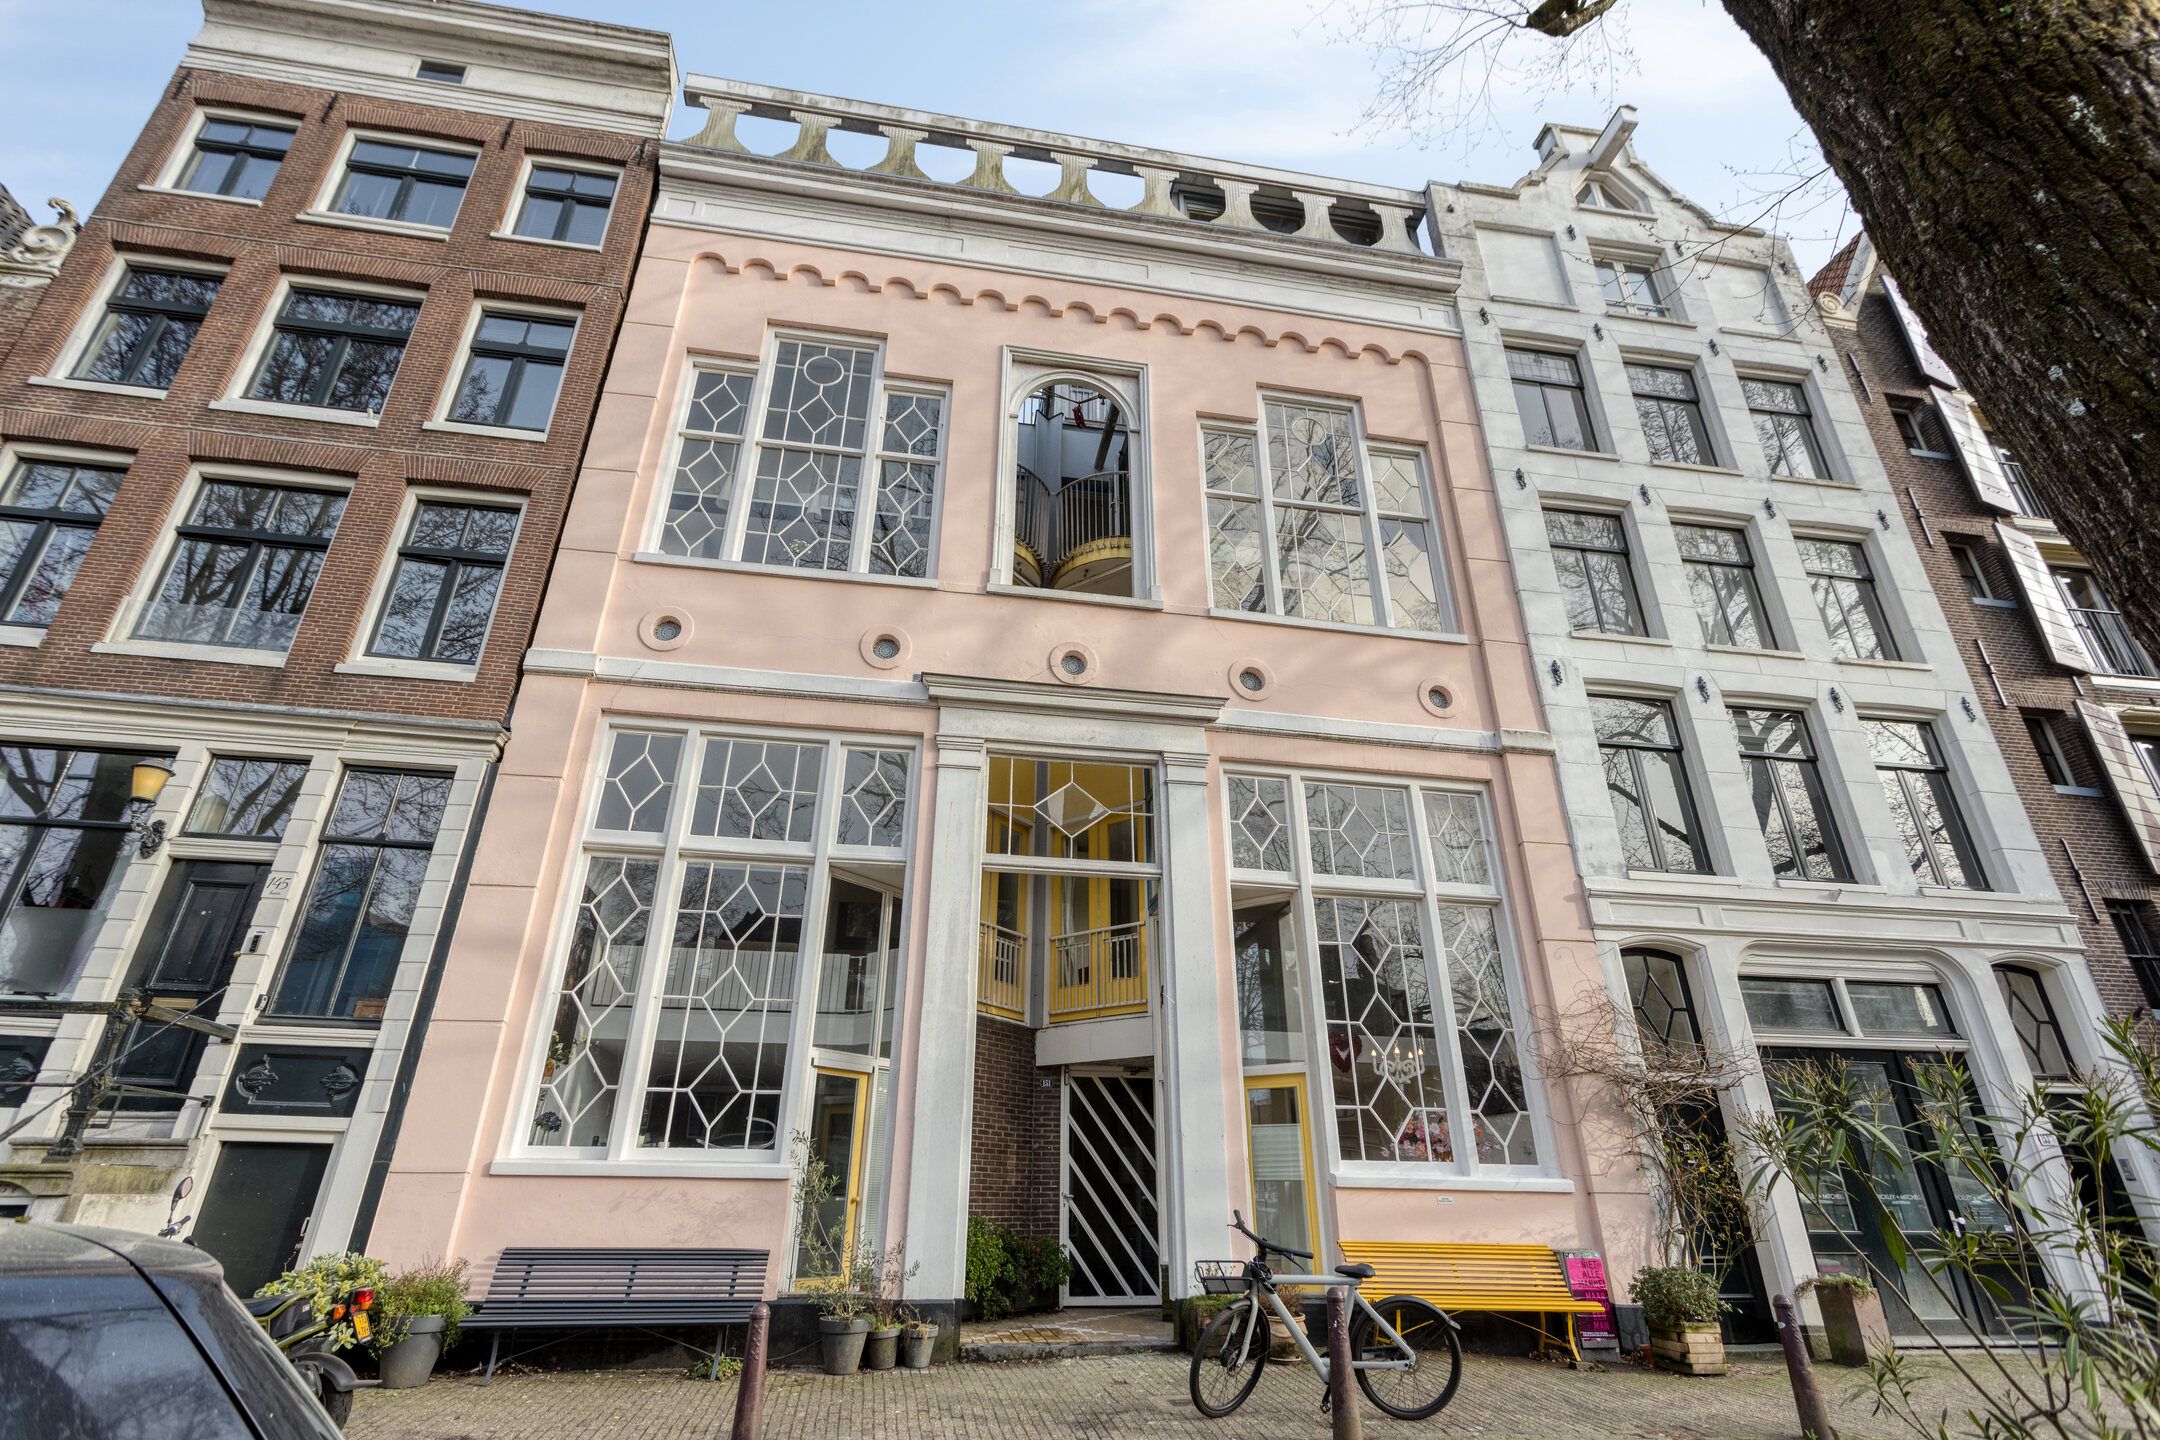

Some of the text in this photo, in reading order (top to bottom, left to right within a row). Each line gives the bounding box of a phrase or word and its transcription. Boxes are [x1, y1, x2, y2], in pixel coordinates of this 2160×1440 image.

[267, 876, 293, 890] 145
[1042, 1079, 1051, 1087] 151
[1581, 1260, 1597, 1269] NIET
[1582, 1270, 1600, 1279] ALLE
[1593, 1321, 1610, 1330] MAN
